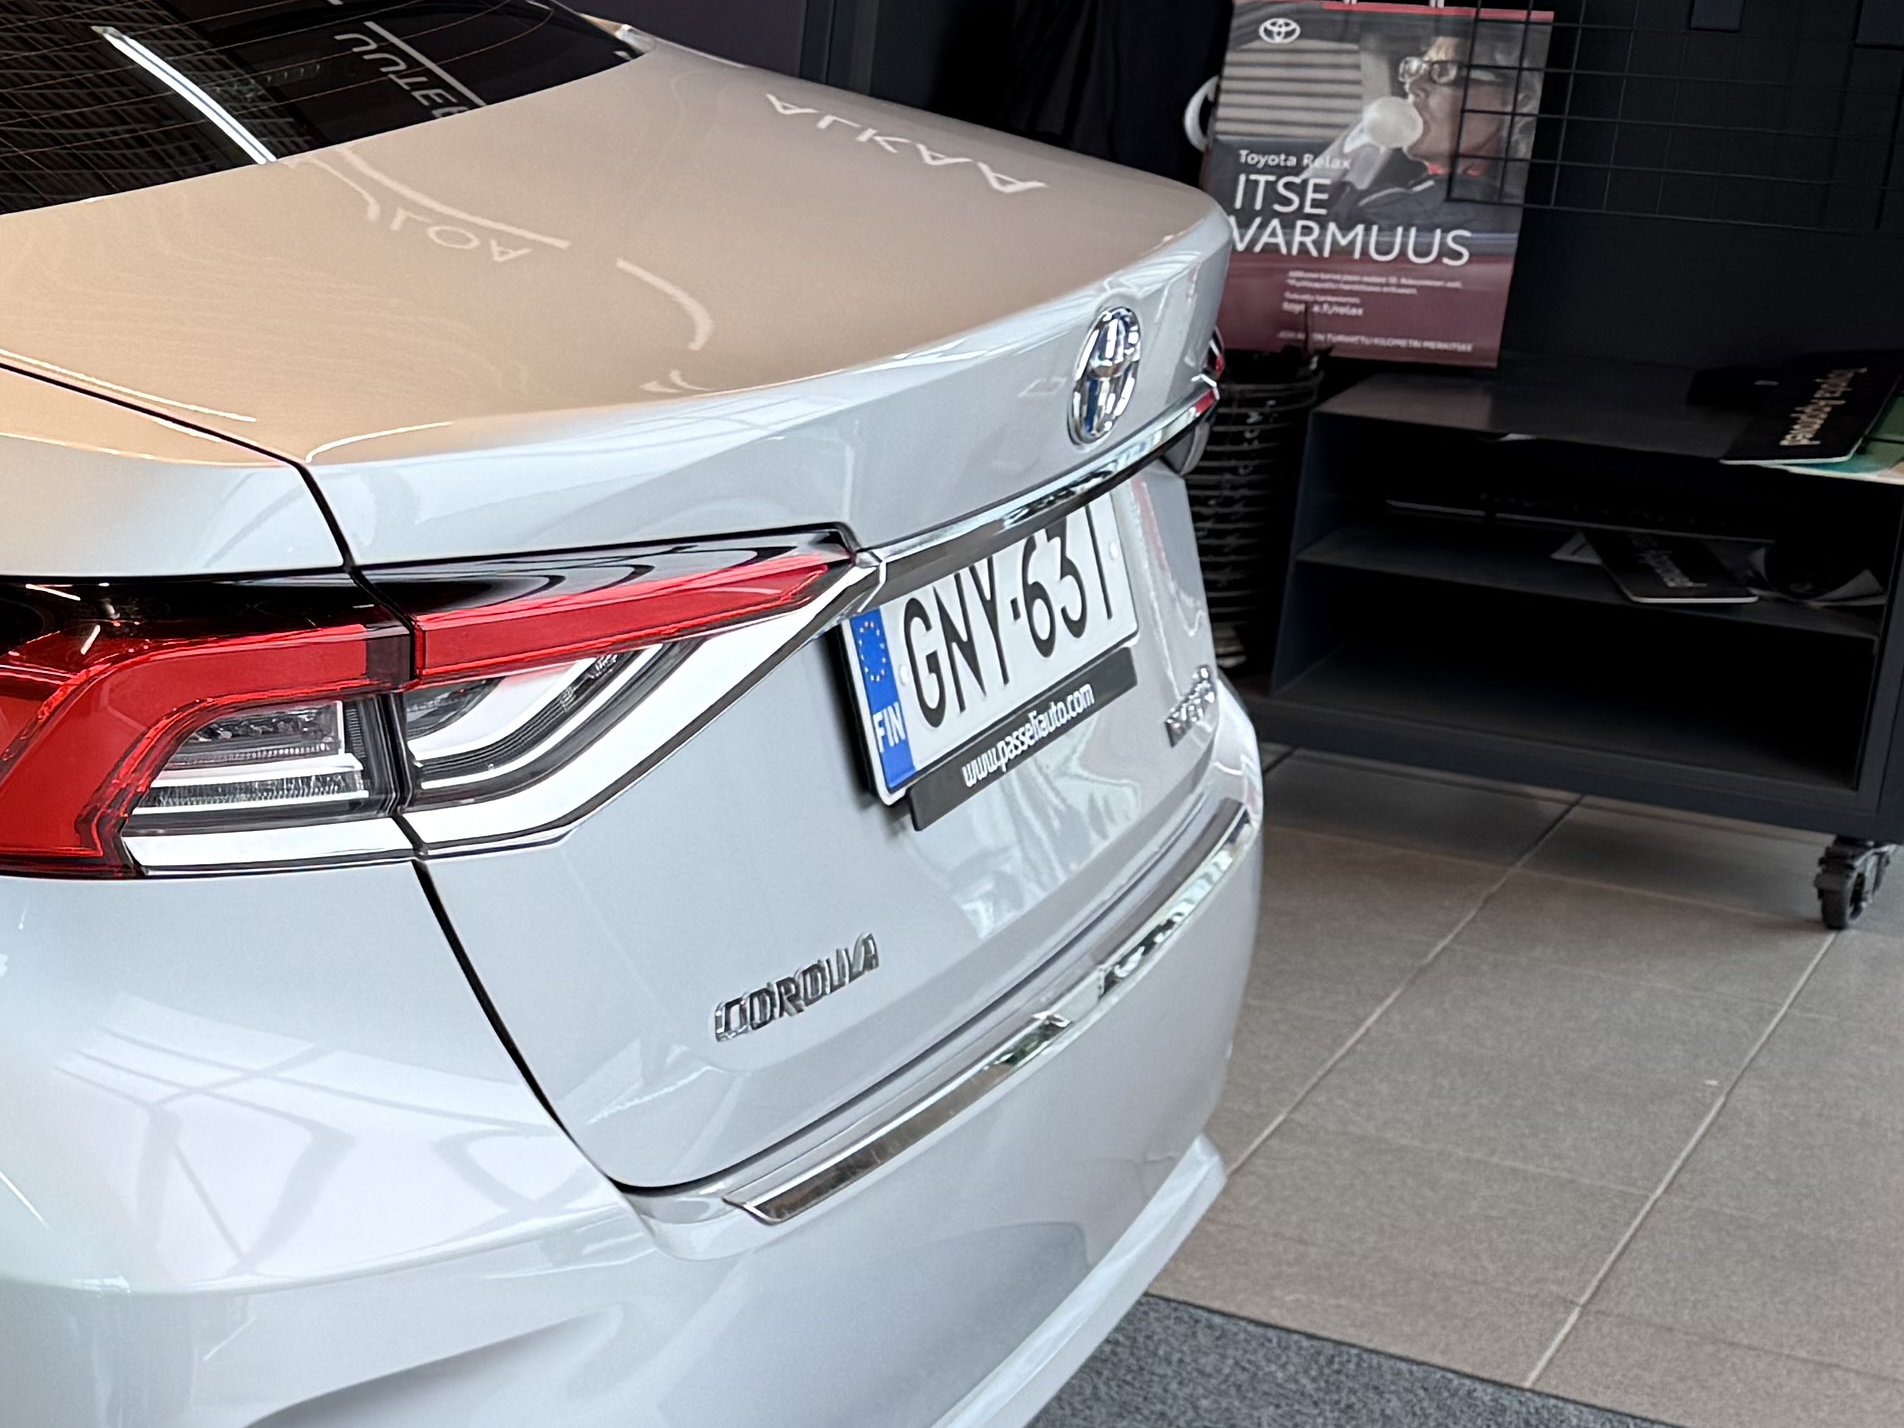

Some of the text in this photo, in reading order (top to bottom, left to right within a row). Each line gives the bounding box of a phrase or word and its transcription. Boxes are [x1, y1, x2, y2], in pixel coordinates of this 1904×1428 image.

[1238, 149, 1352, 170] Toyota Relax
[1234, 173, 1332, 215] ITSE
[1228, 215, 1473, 266] VARMUUS
[903, 502, 1115, 728] GNY-631
[872, 700, 906, 753] FIN
[961, 682, 1096, 788] www.passeliauto.com
